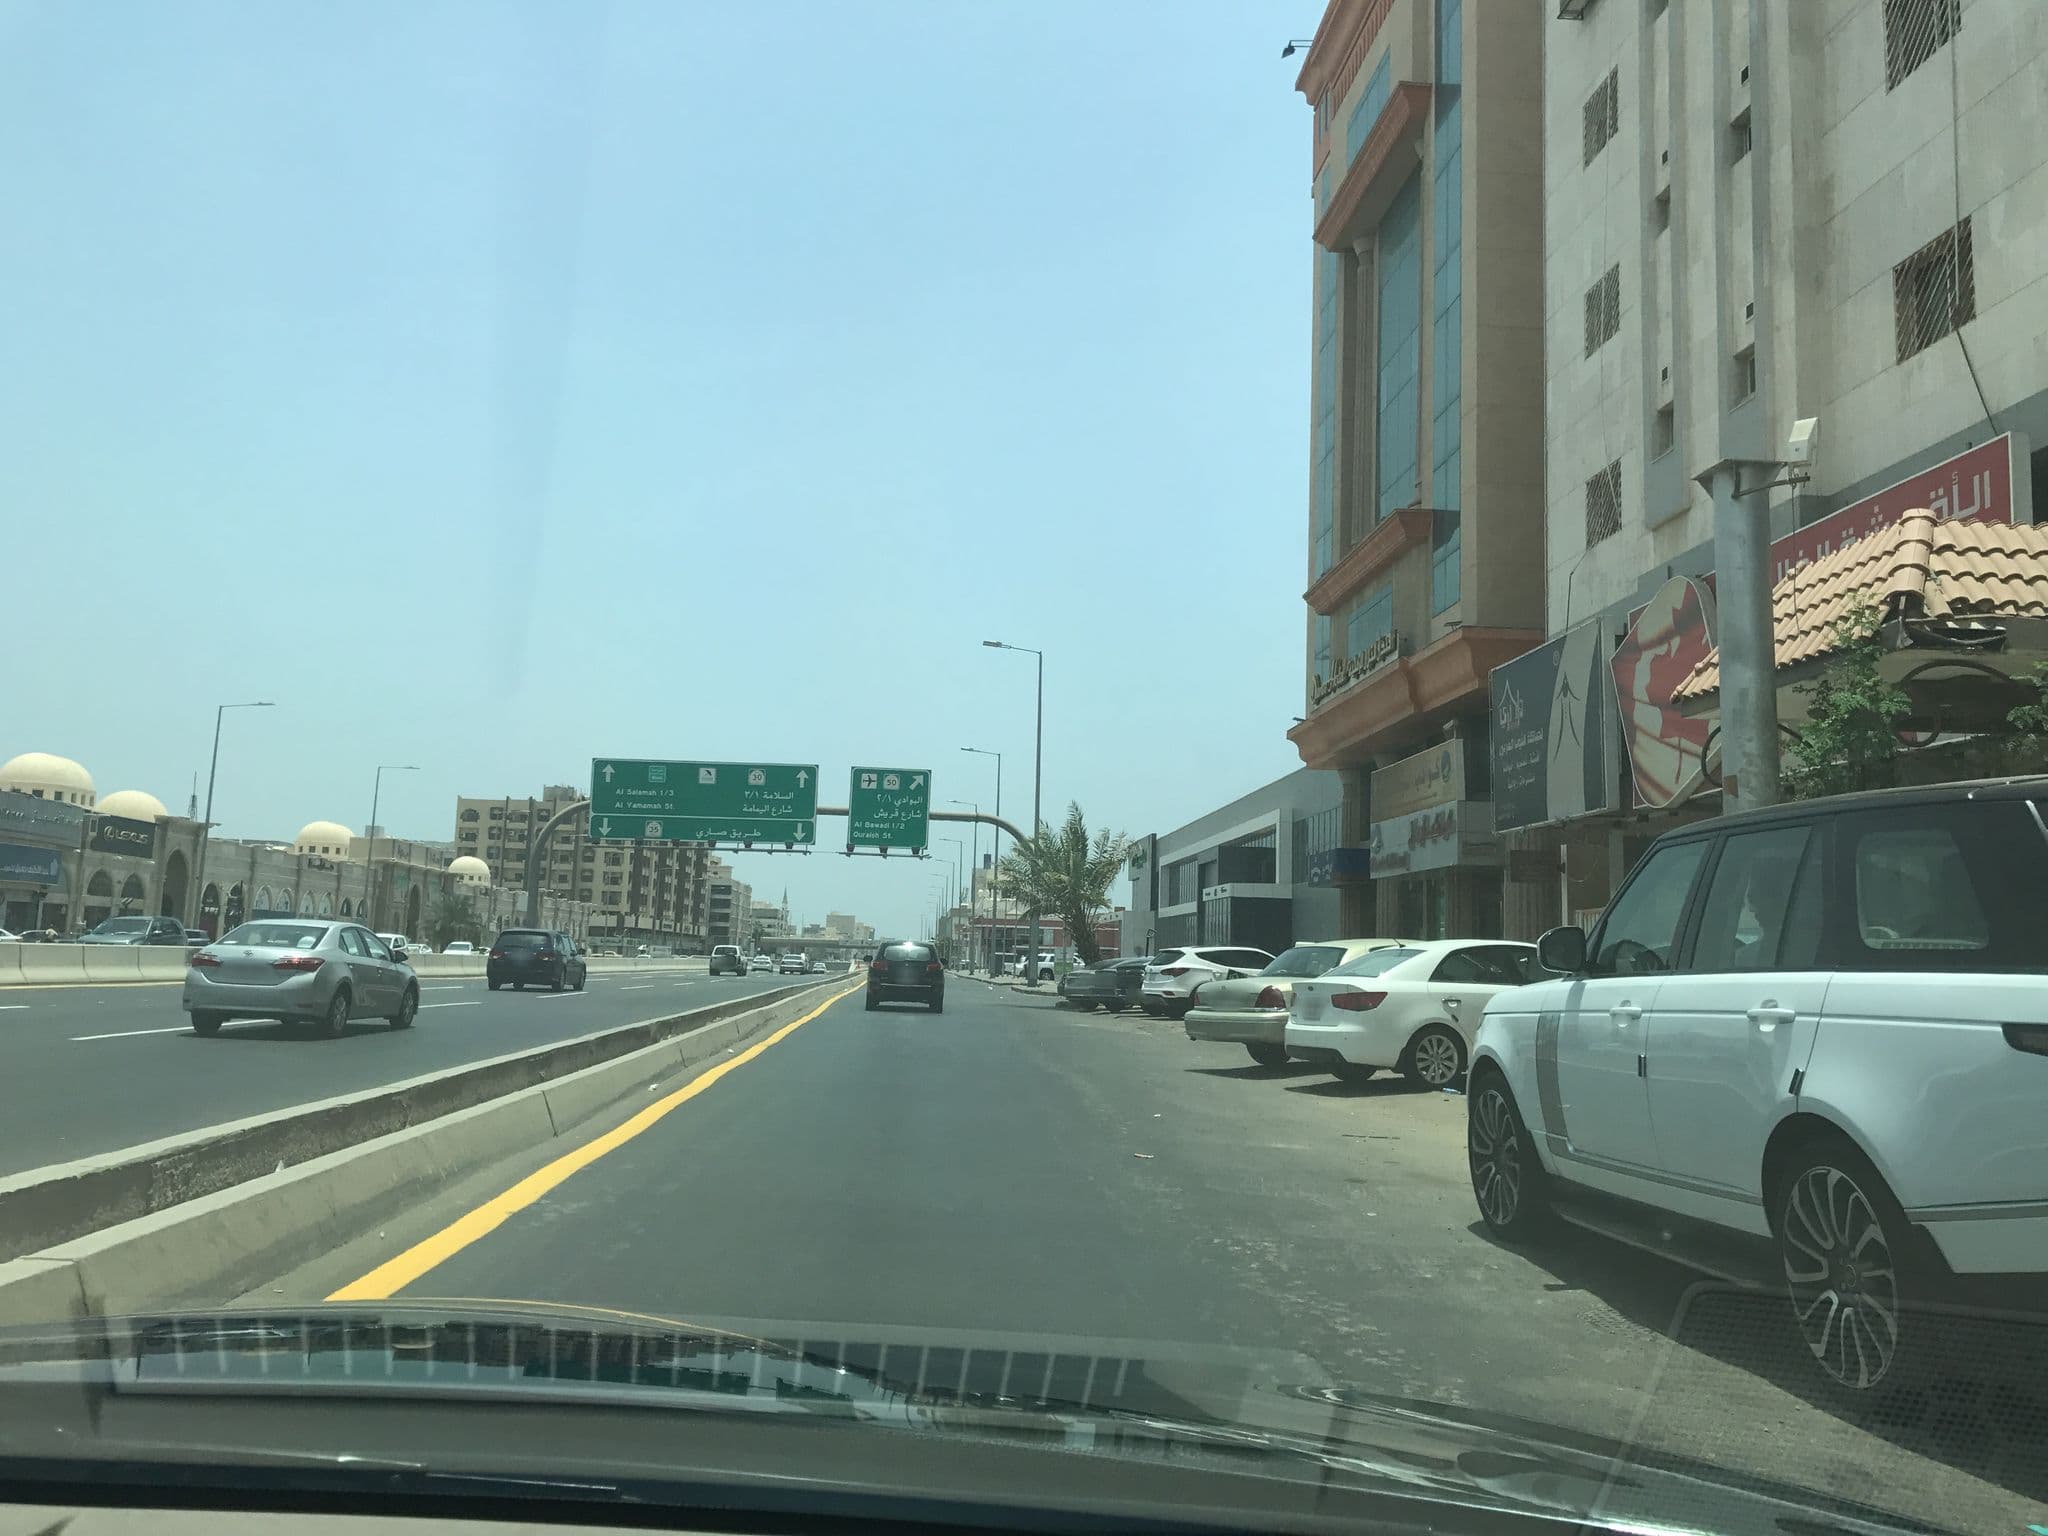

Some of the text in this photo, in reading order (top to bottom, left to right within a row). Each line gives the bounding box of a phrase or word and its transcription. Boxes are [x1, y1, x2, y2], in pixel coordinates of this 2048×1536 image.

[615, 788, 624, 796] Al
[626, 789, 657, 797] Salamah
[763, 791, 794, 800] السلامة
[614, 801, 623, 809] Al
[626, 801, 662, 810] Yamamah
[894, 795, 923, 806] البوادي
[742, 804, 793, 816] شارع اليمامة
[873, 808, 922, 820] شارع قريش
[864, 821, 889, 829] Bawadi
[696, 828, 761, 839] طريق صاري
